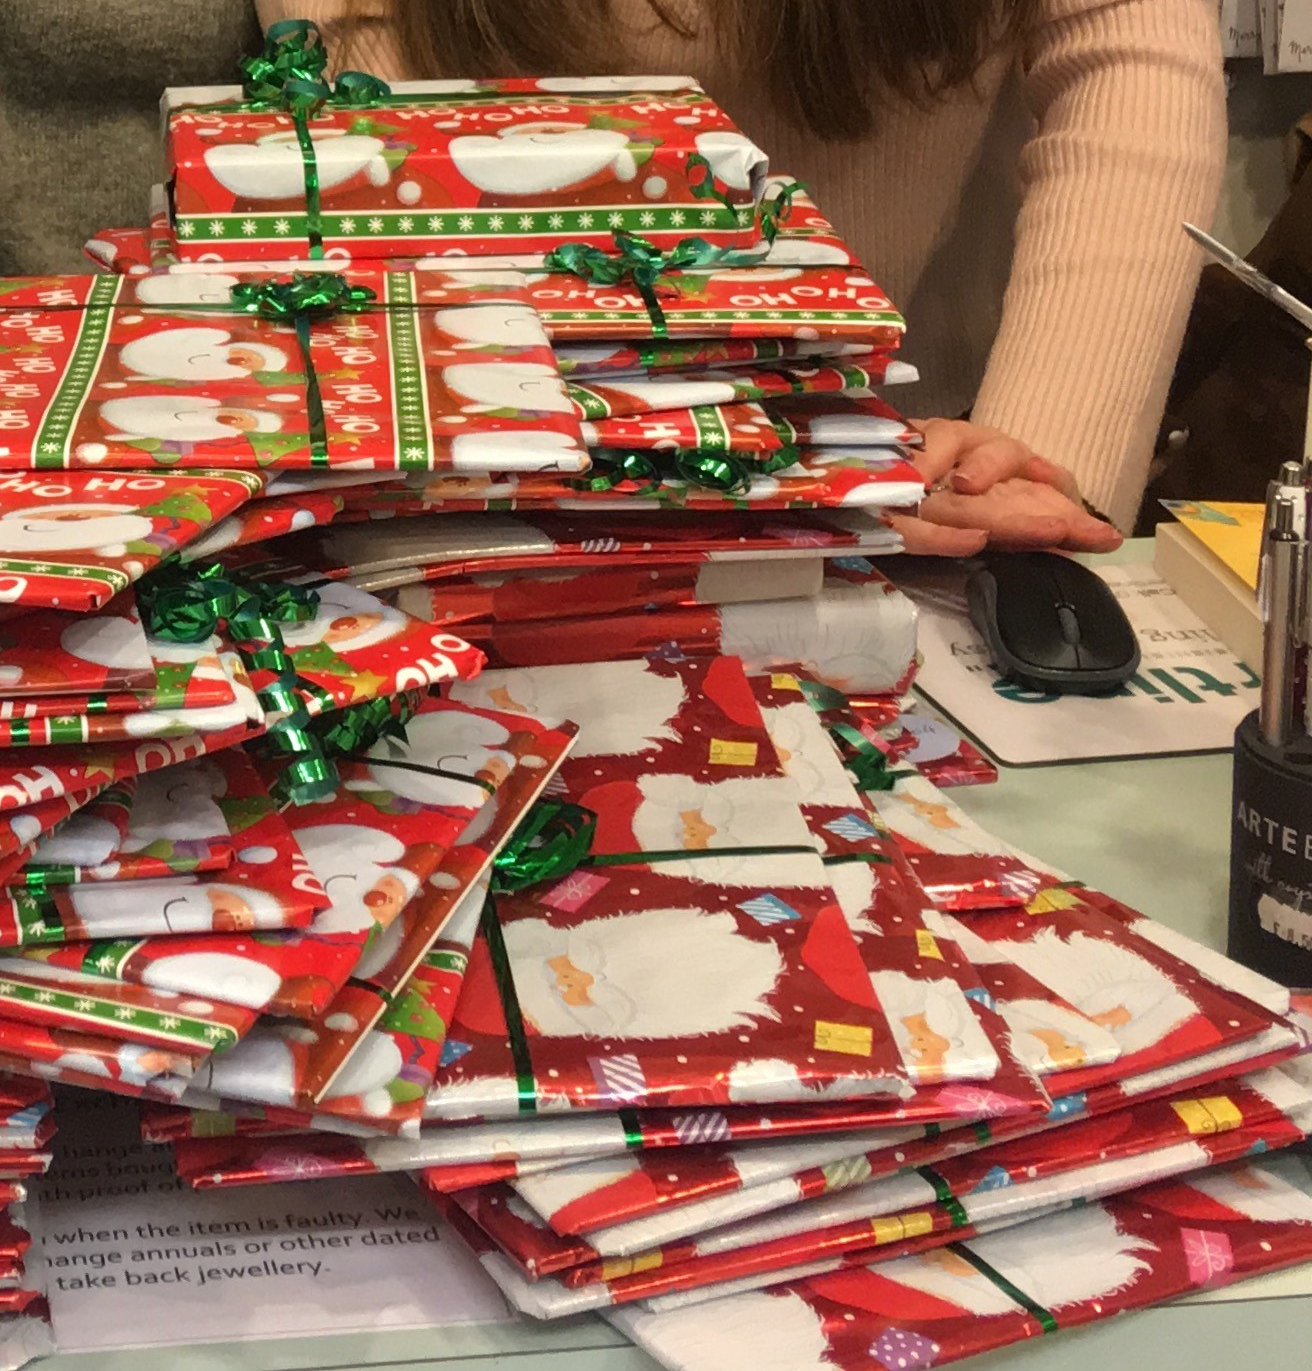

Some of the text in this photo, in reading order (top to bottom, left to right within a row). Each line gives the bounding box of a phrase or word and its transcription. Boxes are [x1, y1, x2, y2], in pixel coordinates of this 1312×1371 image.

[54, 1226, 130, 1246] when
[135, 1221, 181, 1241] the
[188, 1216, 250, 1237] item
[257, 1214, 280, 1232] is
[375, 1205, 421, 1223] We
[130, 1239, 237, 1264] annuals
[243, 1241, 269, 1256] or
[278, 1232, 353, 1254] other
[360, 1226, 441, 1248] dated
[56, 1271, 117, 1292] take
[122, 1266, 190, 1287] back
